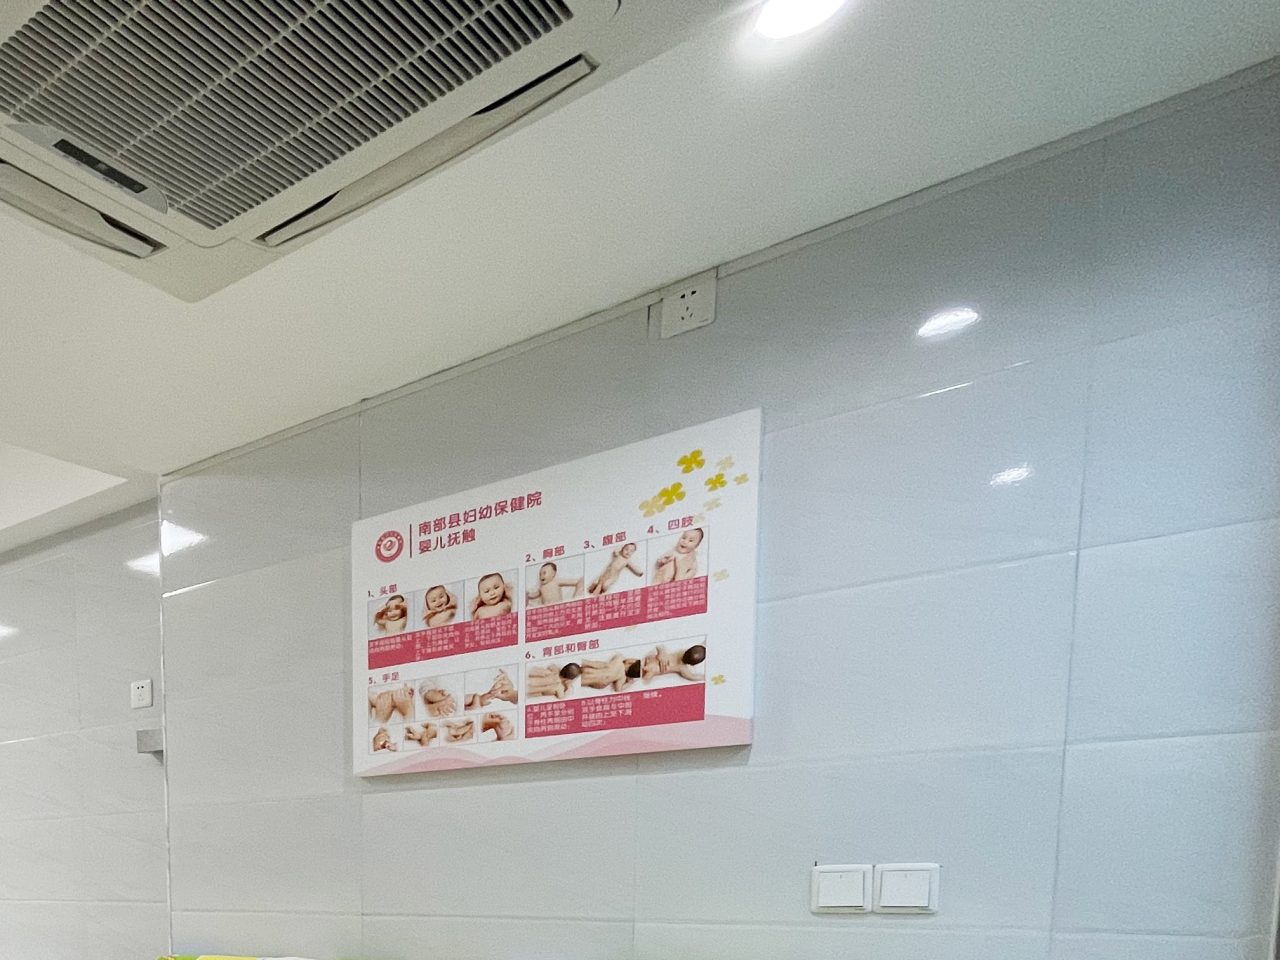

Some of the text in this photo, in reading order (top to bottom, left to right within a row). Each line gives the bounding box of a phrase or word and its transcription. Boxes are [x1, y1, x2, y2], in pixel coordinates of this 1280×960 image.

[418, 491, 543, 537] 南部县妇幼保健院
[418, 528, 476, 555] 婴儿抚触
